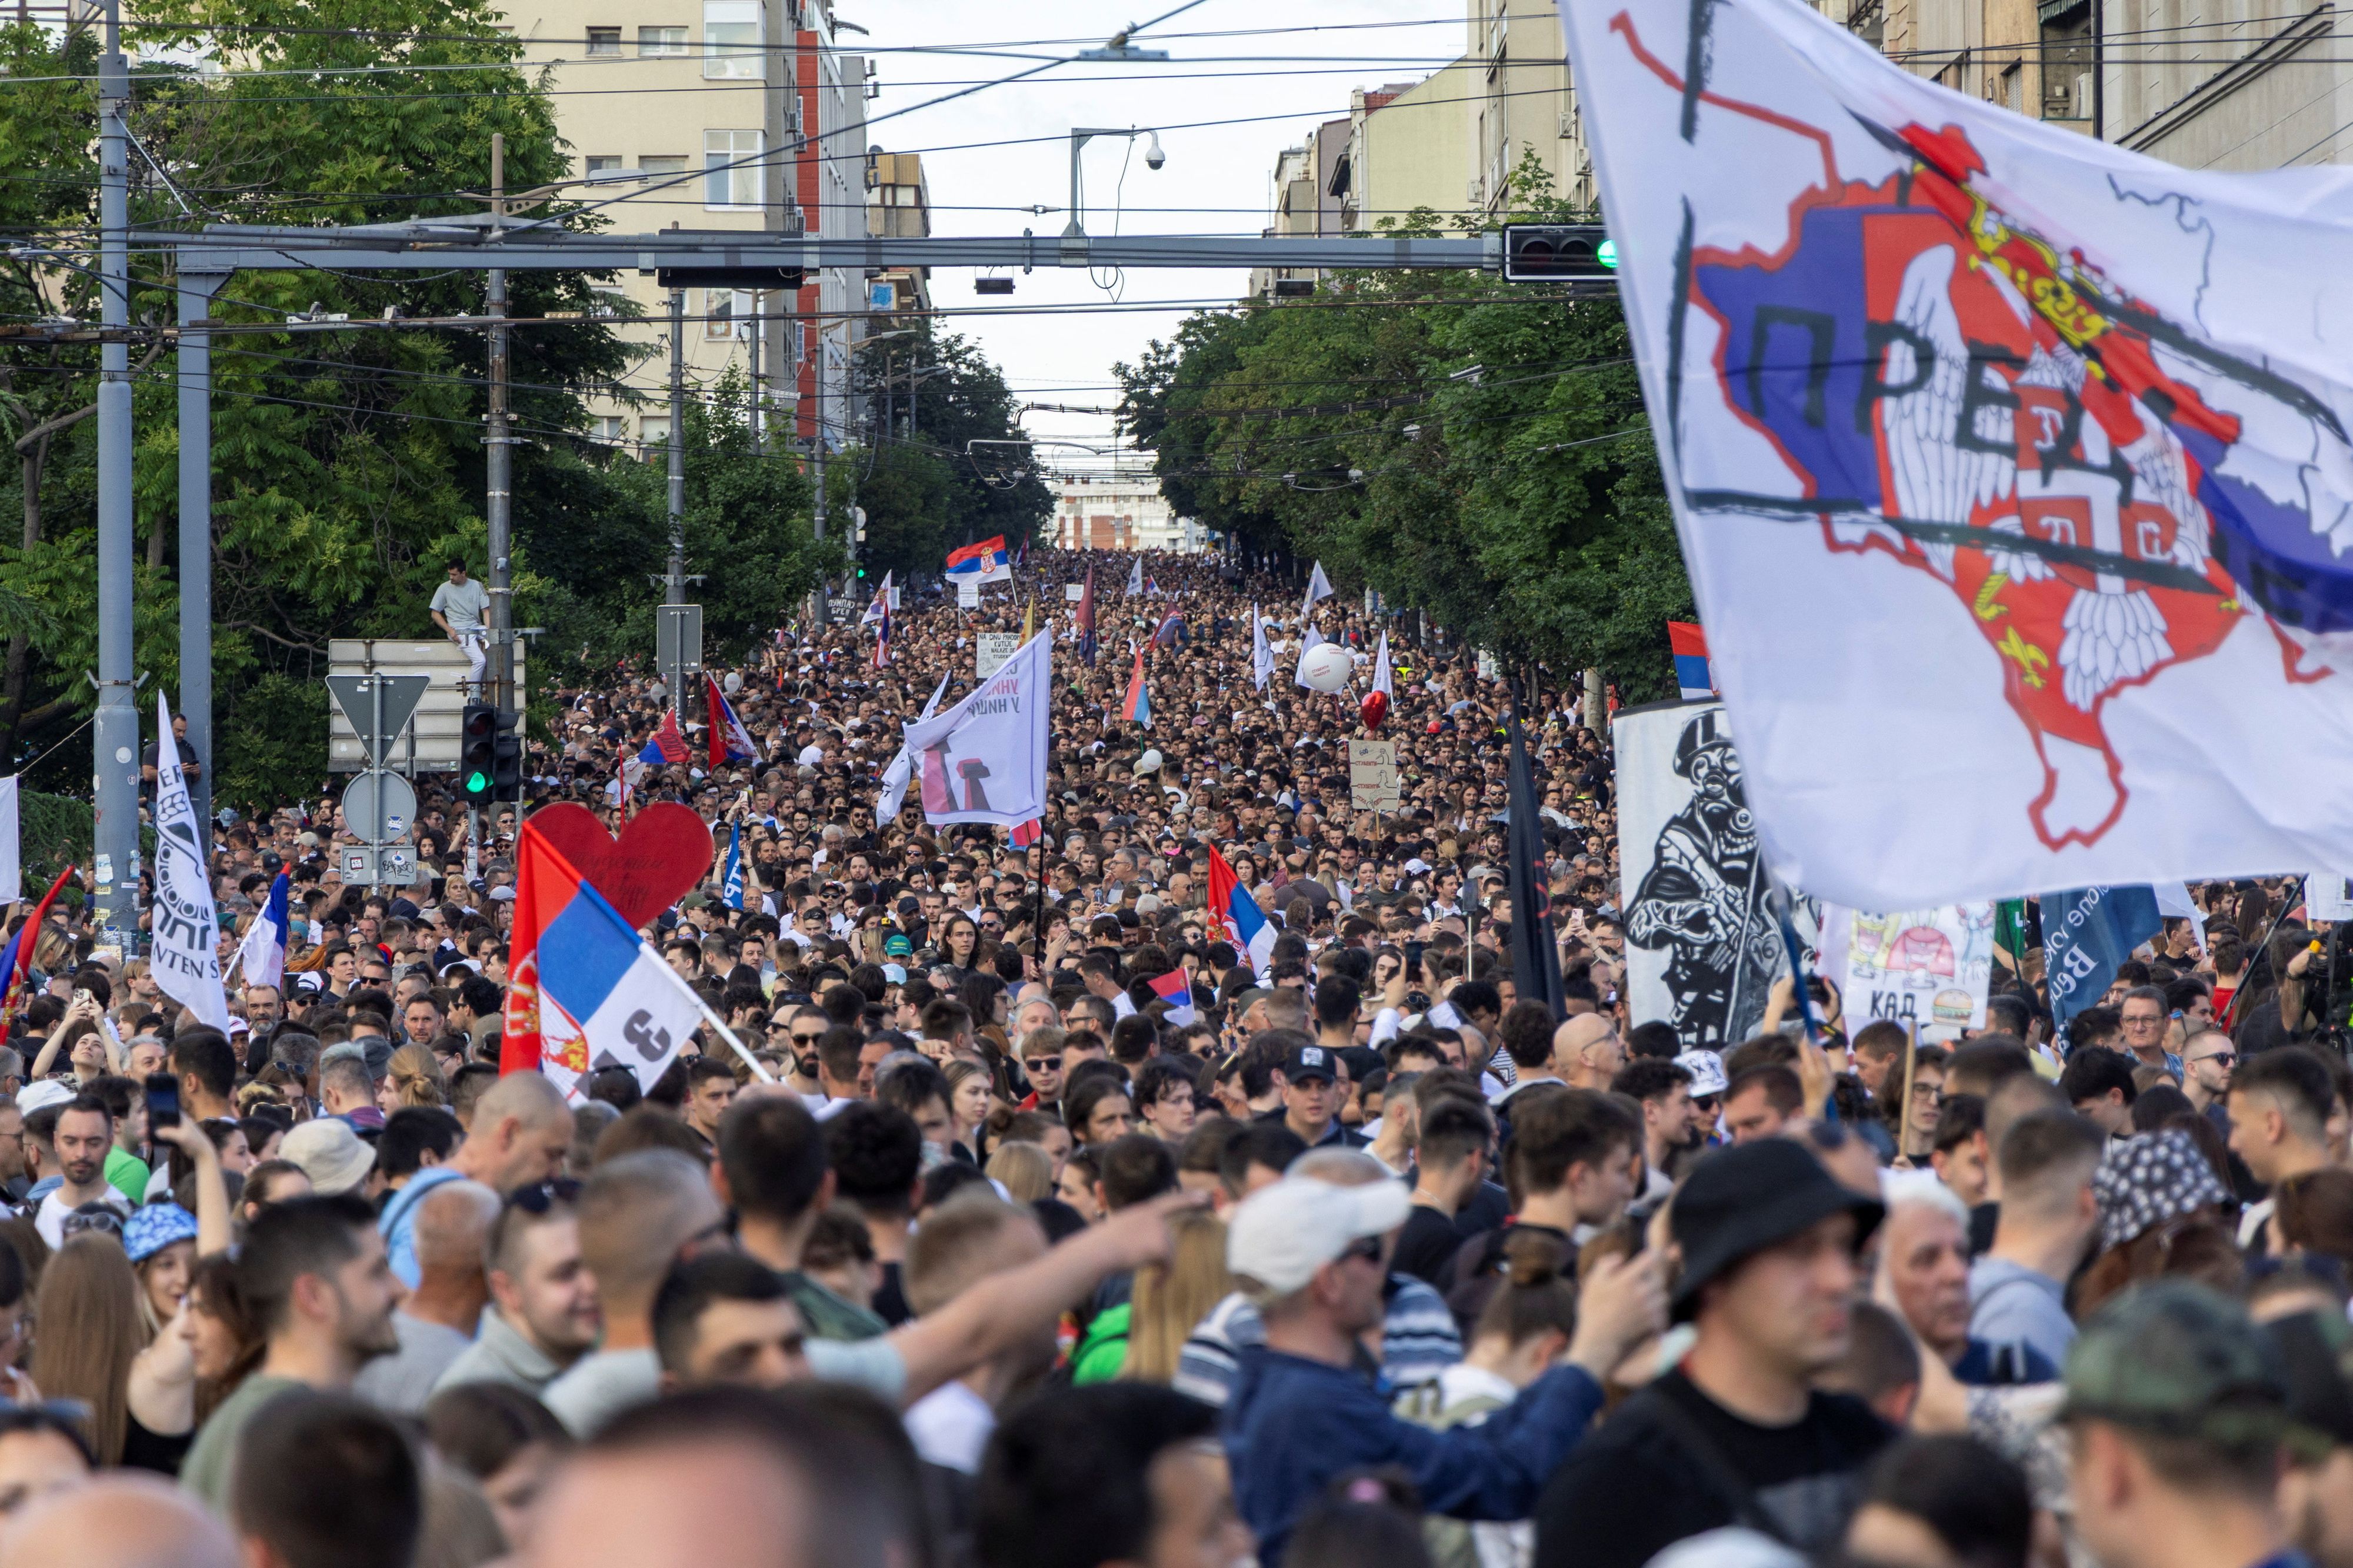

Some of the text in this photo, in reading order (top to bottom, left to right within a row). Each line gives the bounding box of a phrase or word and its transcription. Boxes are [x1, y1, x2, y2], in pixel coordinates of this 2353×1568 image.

[828, 598, 855, 609] ПУМПАЈ
[1753, 940, 1776, 964] 16
[1871, 990, 1918, 1020] КАД
